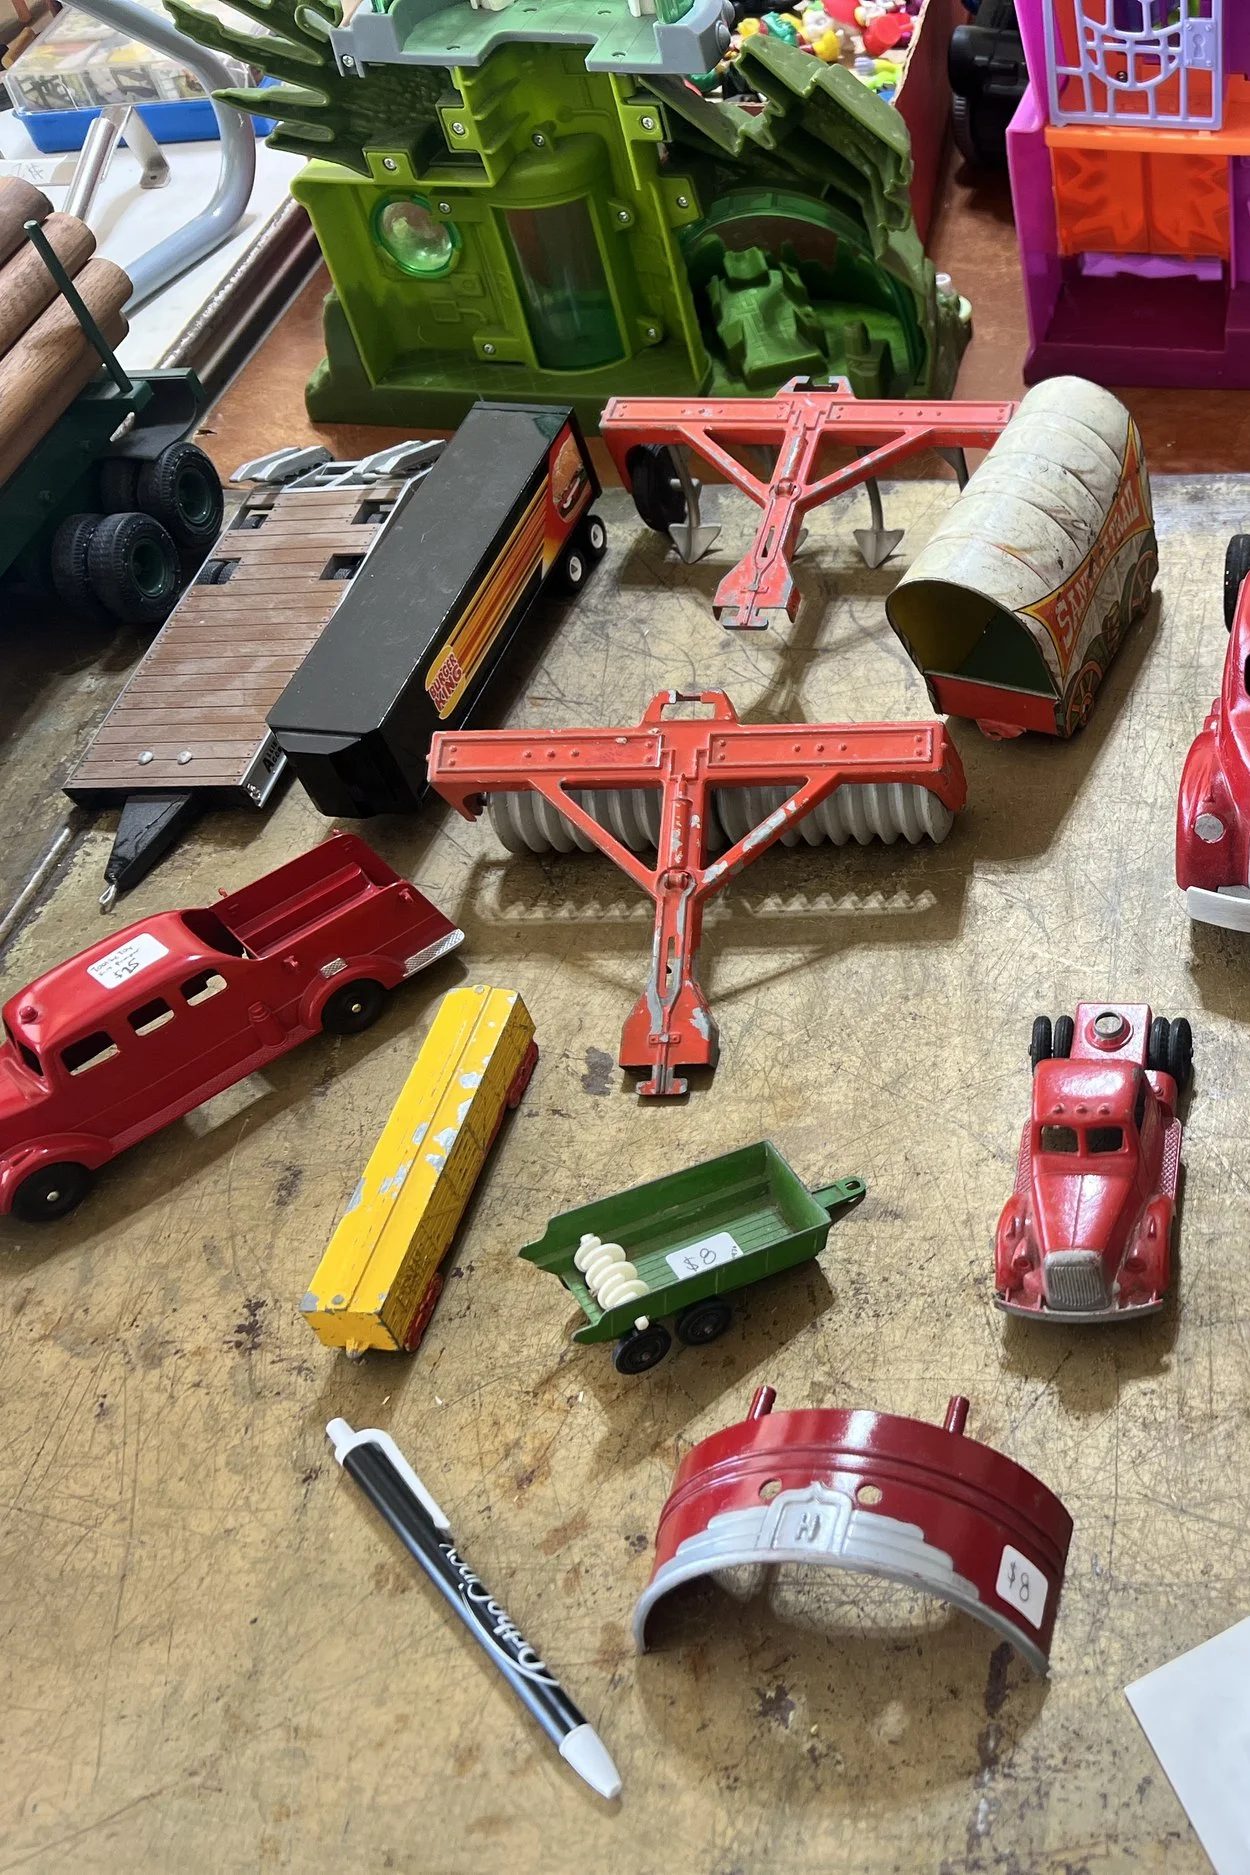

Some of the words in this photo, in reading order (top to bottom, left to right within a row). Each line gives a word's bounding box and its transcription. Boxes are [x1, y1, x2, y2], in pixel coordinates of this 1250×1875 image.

[429, 653, 457, 699] BURGER
[435, 664, 462, 711] KING
[112, 957, 140, 979] $25
[1007, 1560, 1030, 1603] $8
